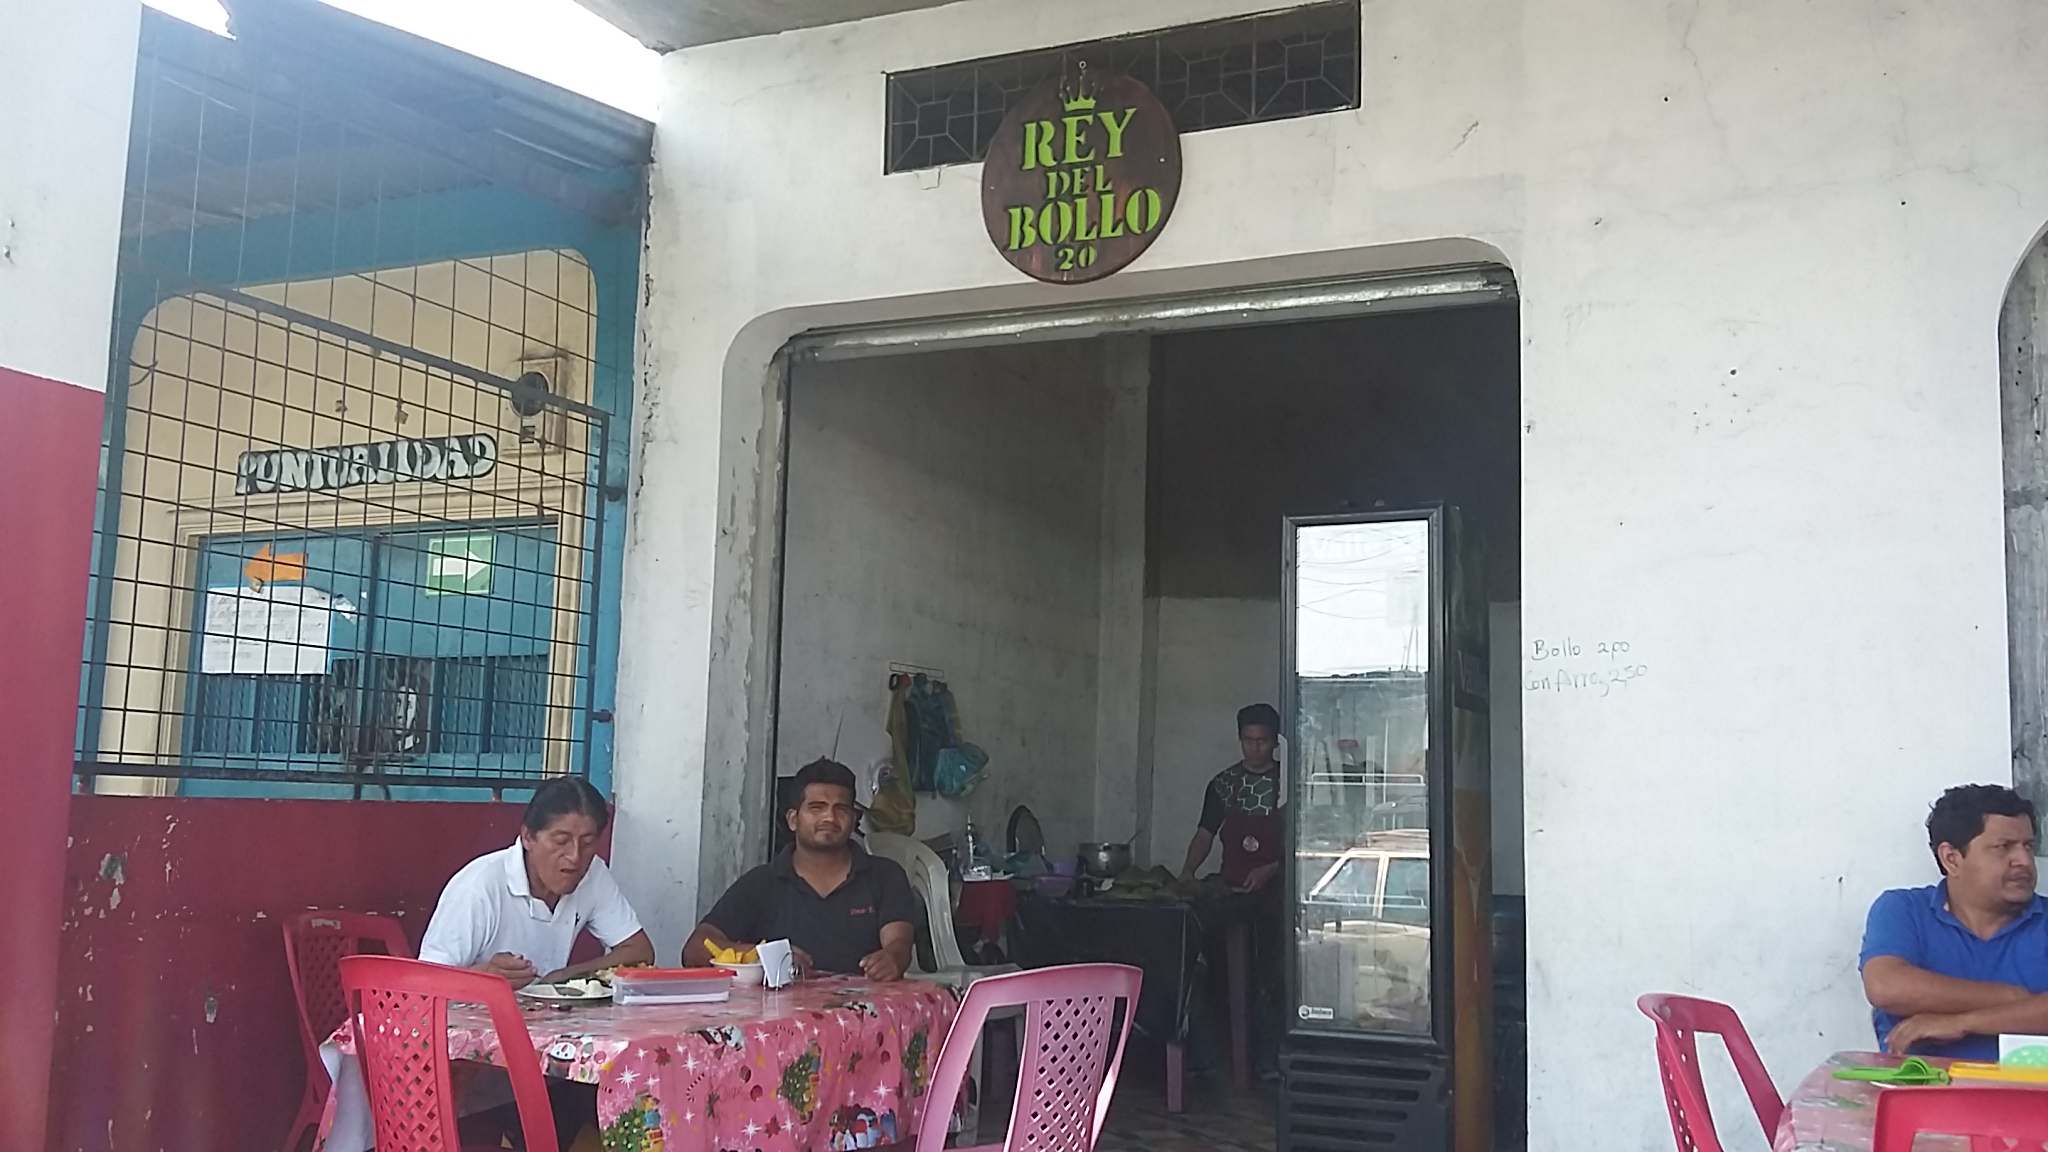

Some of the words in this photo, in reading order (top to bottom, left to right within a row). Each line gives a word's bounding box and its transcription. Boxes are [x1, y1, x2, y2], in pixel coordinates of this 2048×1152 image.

[1022, 107, 1137, 170] REY
[1046, 164, 1113, 199] DEL
[1007, 188, 1162, 250] BOLLO
[1057, 245, 1096, 270] 20
[1531, 637, 1581, 661] Bollo
